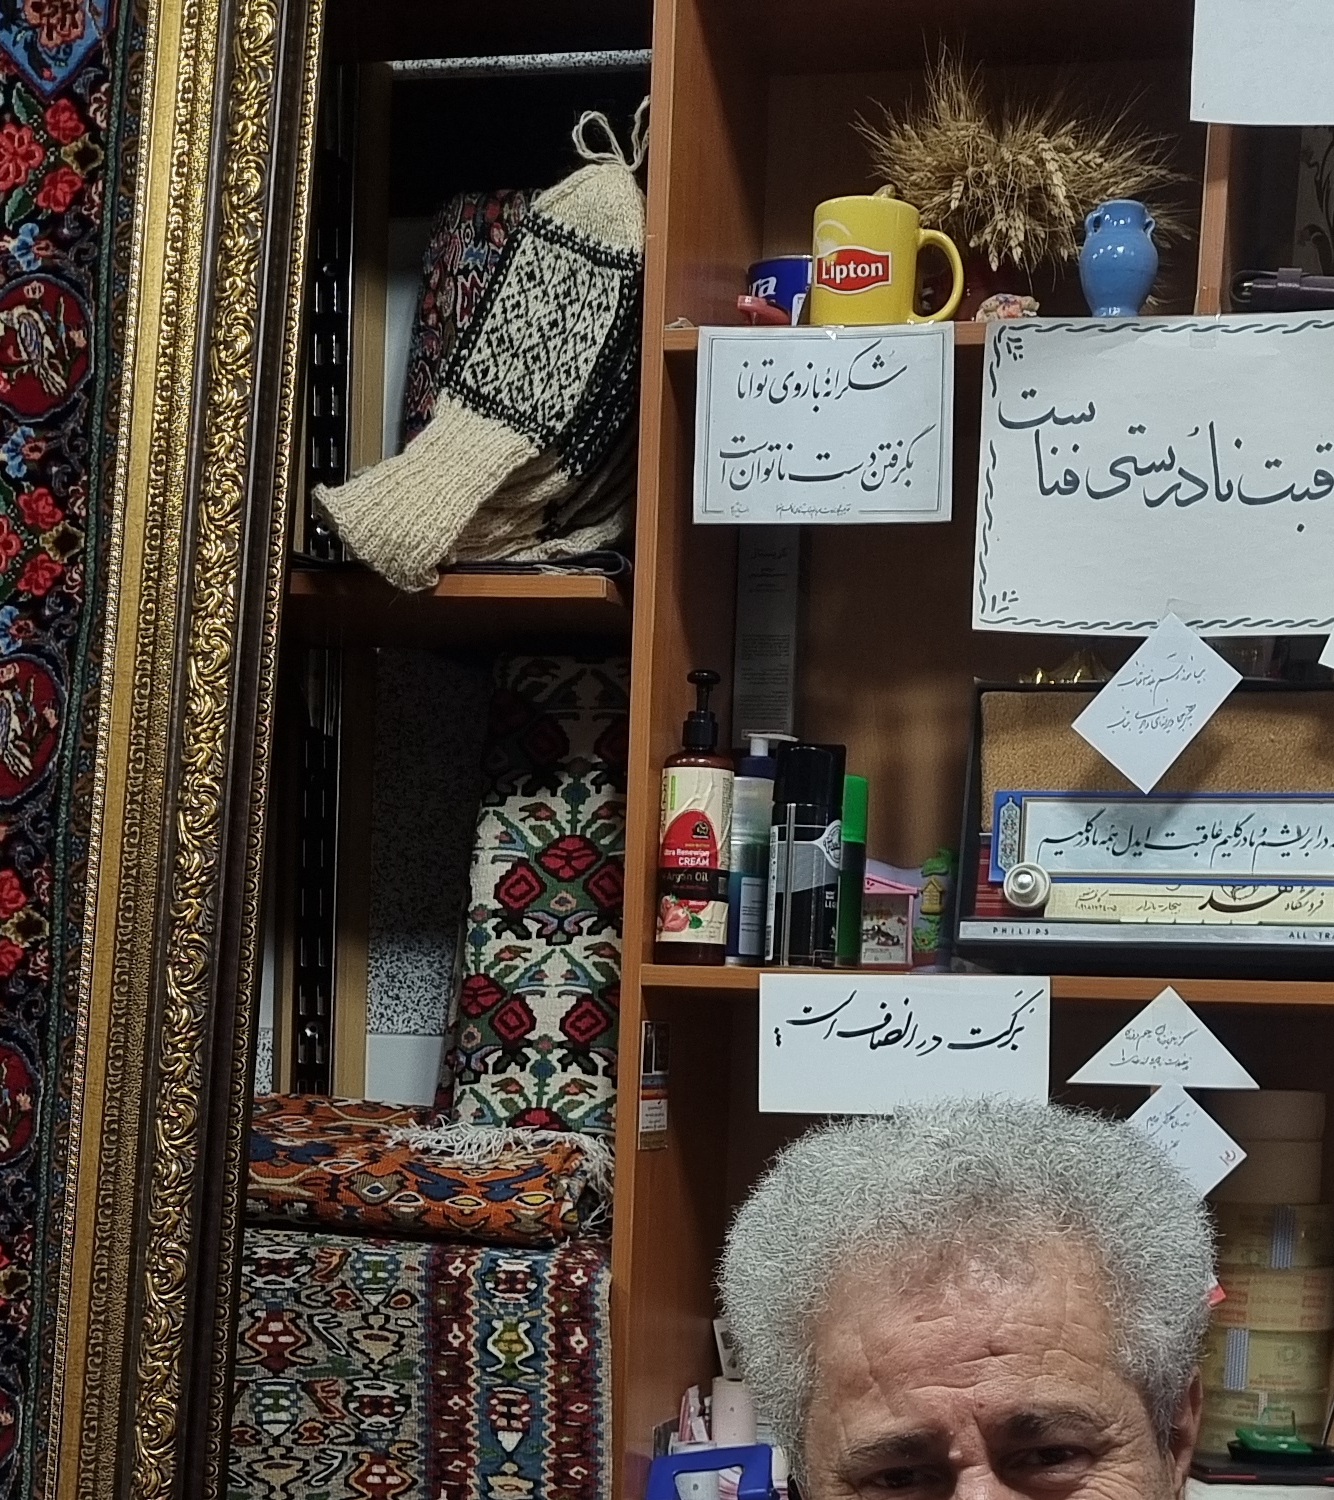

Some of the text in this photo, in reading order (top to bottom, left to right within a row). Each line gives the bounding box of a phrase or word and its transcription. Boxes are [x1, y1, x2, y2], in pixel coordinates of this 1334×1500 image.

[821, 259, 884, 284] Lipton
[736, 357, 775, 400] توانا
[767, 361, 821, 413] بازوی
[719, 435, 769, 485] است
[728, 442, 795, 491] ناتوان
[788, 450, 877, 483] دست
[1084, 420, 1244, 509] نادرستی
[1035, 807, 1107, 864] گلیم
[1143, 819, 1223, 858] عاقبت
[1209, 812, 1256, 869] گلیم
[678, 857, 710, 867] CREAM
[694, 871, 709, 882] Oil
[992, 926, 1051, 937] PHILIPS
[1288, 930, 1309, 940] ALL
[785, 988, 1045, 1057] برکت در انصاف است
